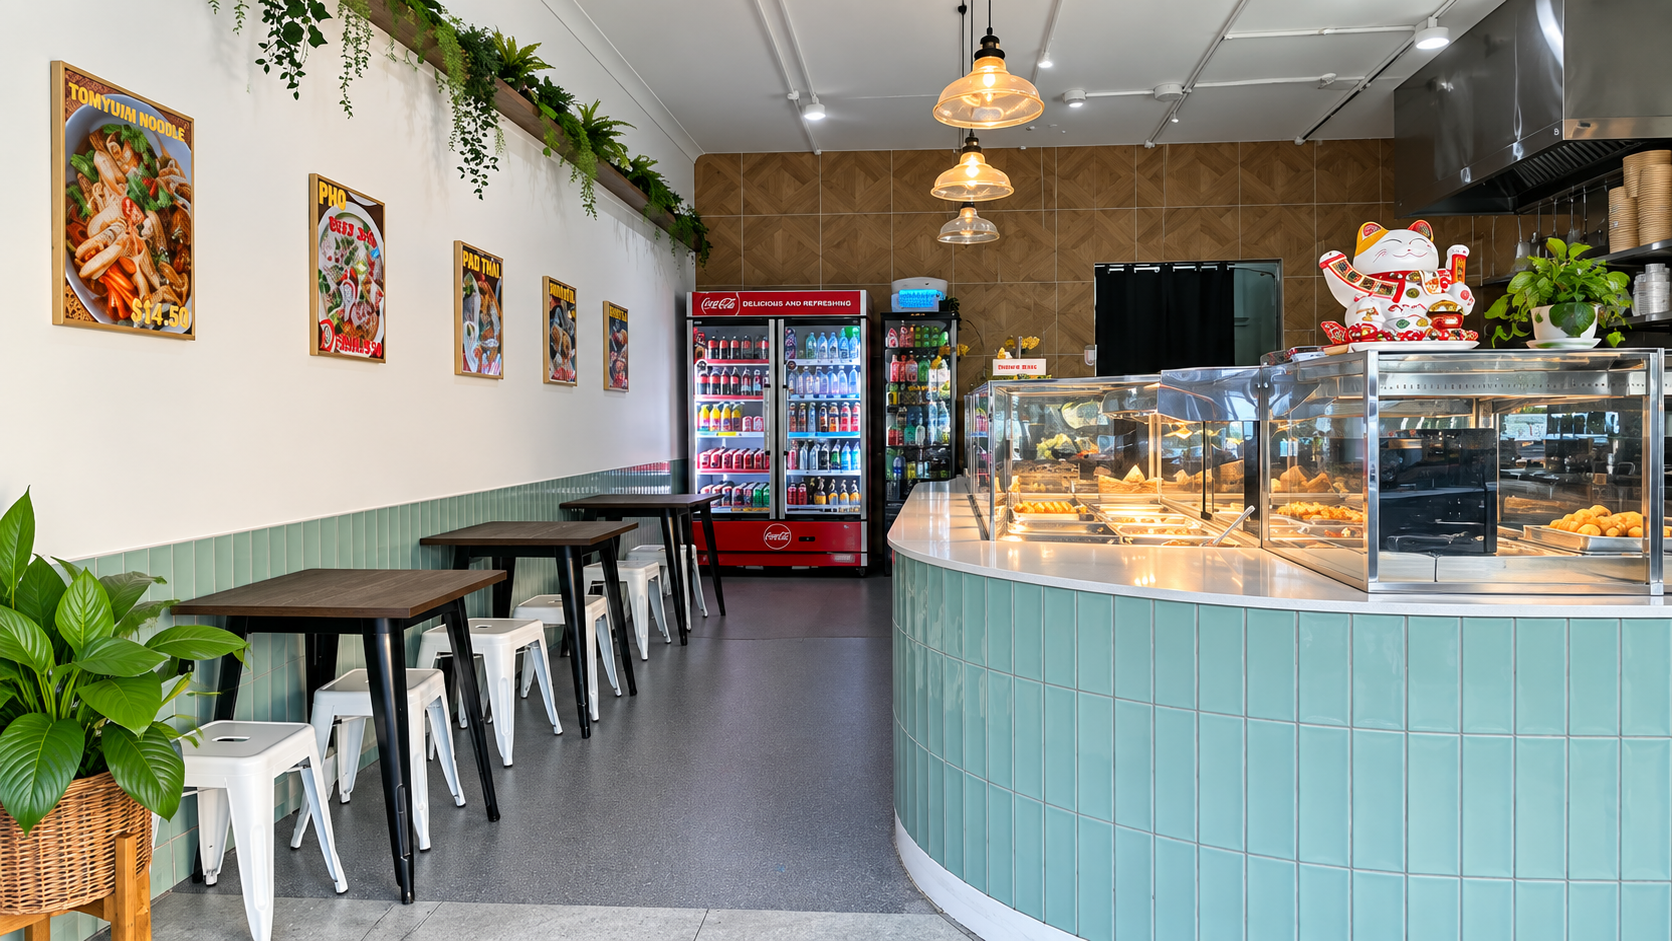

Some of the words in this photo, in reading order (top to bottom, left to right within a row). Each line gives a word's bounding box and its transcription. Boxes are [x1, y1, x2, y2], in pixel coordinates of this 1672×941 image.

[139, 111, 186, 142] NOODLE
[318, 180, 347, 211] PHO
[462, 250, 480, 272] PAD
[130, 297, 190, 330] $14.50
[742, 300, 784, 308] DELICIOUS
[785, 300, 802, 308] AND
[802, 300, 852, 308] REFRESHING
